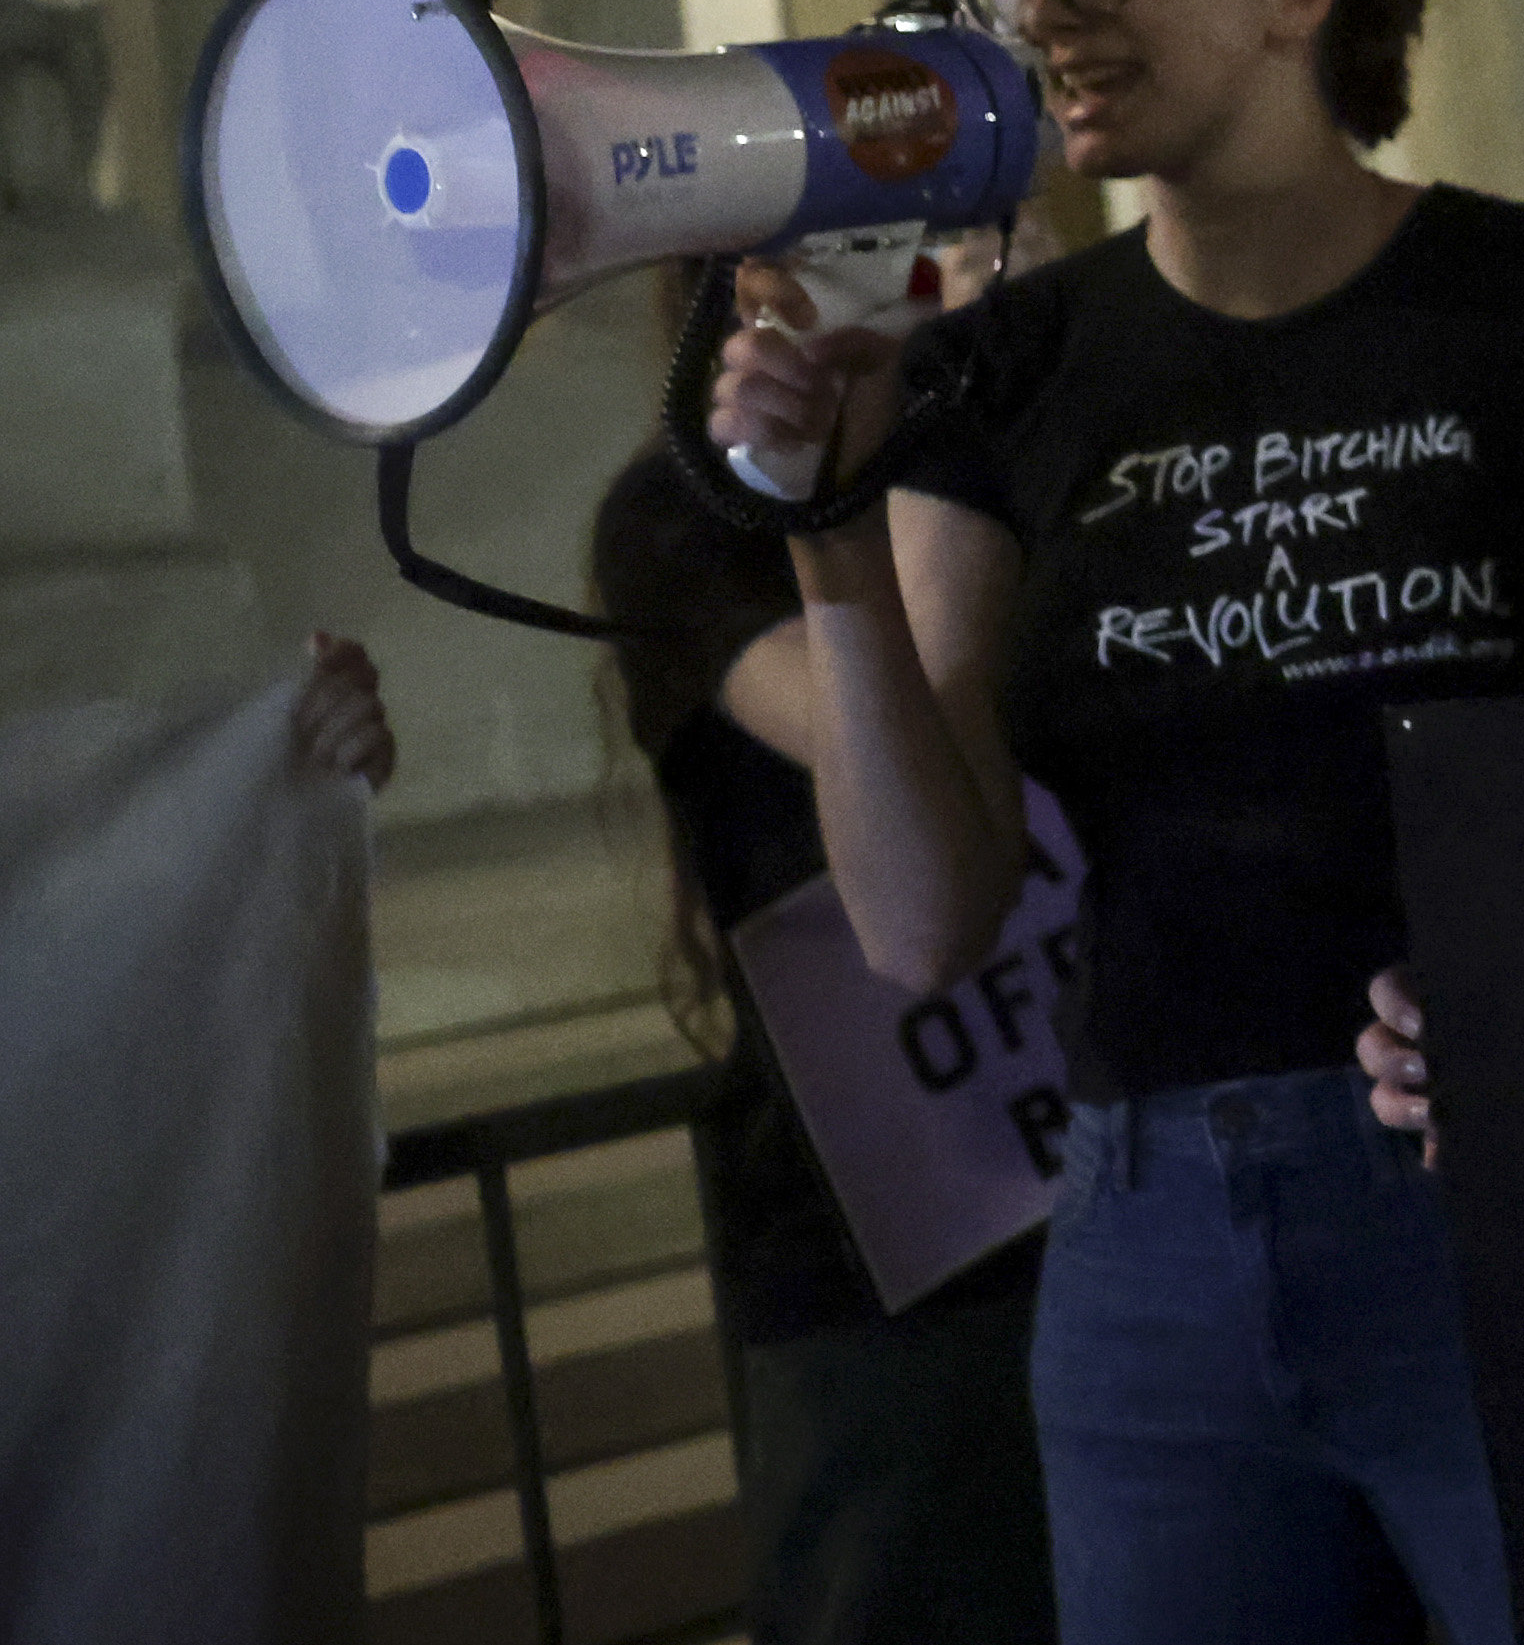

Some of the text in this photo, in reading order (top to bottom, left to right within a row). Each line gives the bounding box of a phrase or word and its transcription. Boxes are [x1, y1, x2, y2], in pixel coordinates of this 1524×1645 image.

[611, 131, 699, 185] PYLE
[1081, 414, 1475, 525] STOP BITCHING
[1189, 487, 1371, 557] START
[1266, 545, 1298, 587] A
[1098, 560, 1495, 668] REVOLUTION
